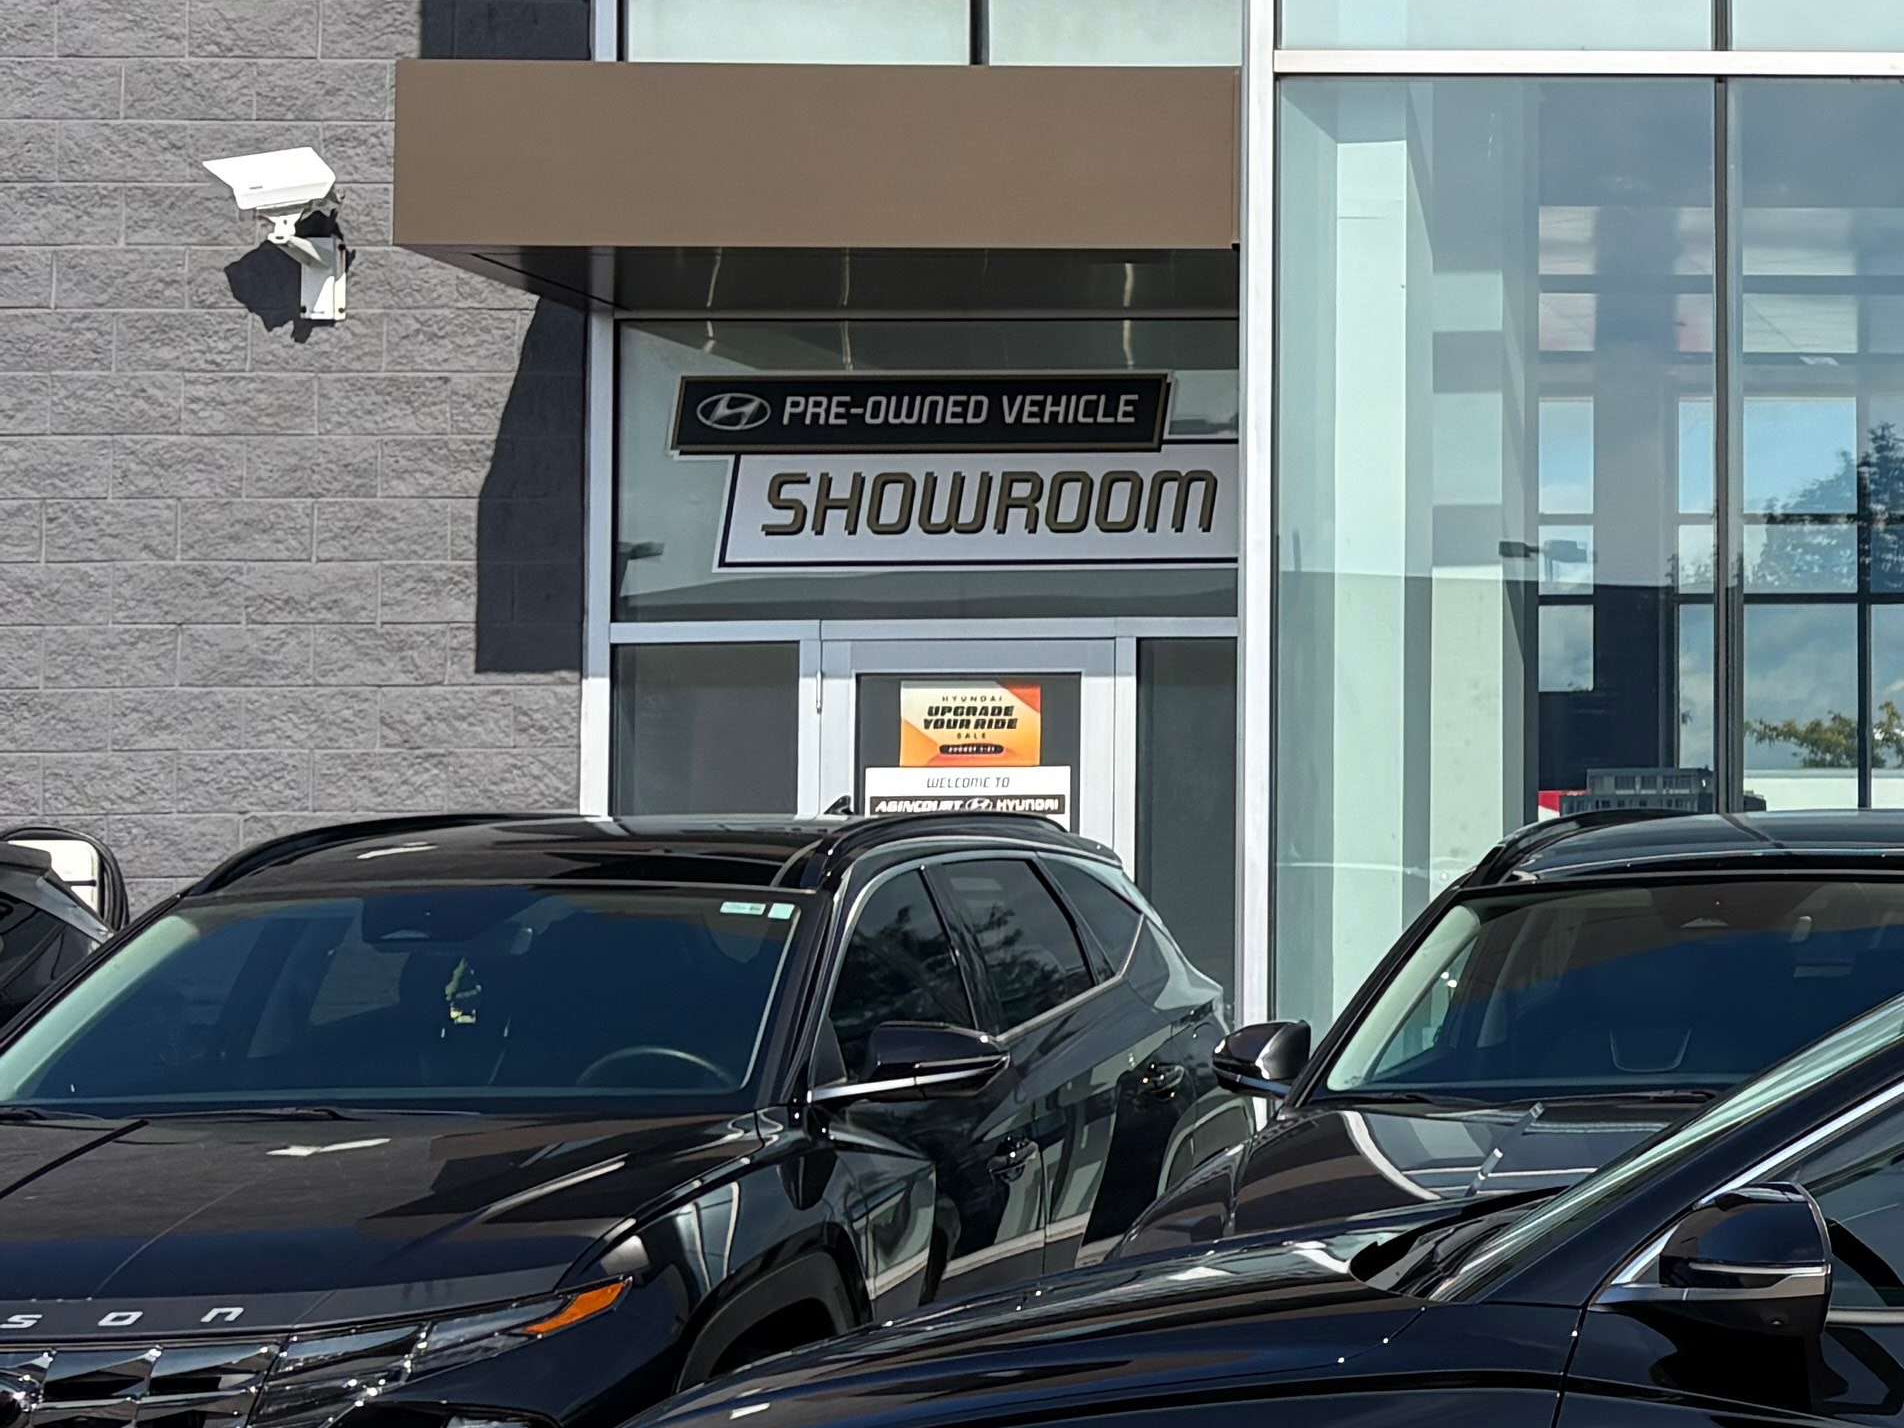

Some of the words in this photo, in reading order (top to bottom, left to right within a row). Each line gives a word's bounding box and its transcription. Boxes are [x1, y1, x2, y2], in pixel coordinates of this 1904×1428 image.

[782, 395, 988, 426] PRE-OWNED
[1003, 394, 1140, 424] VEHICLE
[761, 469, 1218, 538] SHOWROOM
[927, 705, 1015, 717] UPGRADE
[923, 718, 972, 730] YOUR
[973, 718, 1019, 730] RIDE
[956, 732, 987, 740] SALE
[926, 777, 991, 789] WELCOME
[995, 776, 1010, 788] TO
[996, 798, 1059, 811] HYUNDAI
